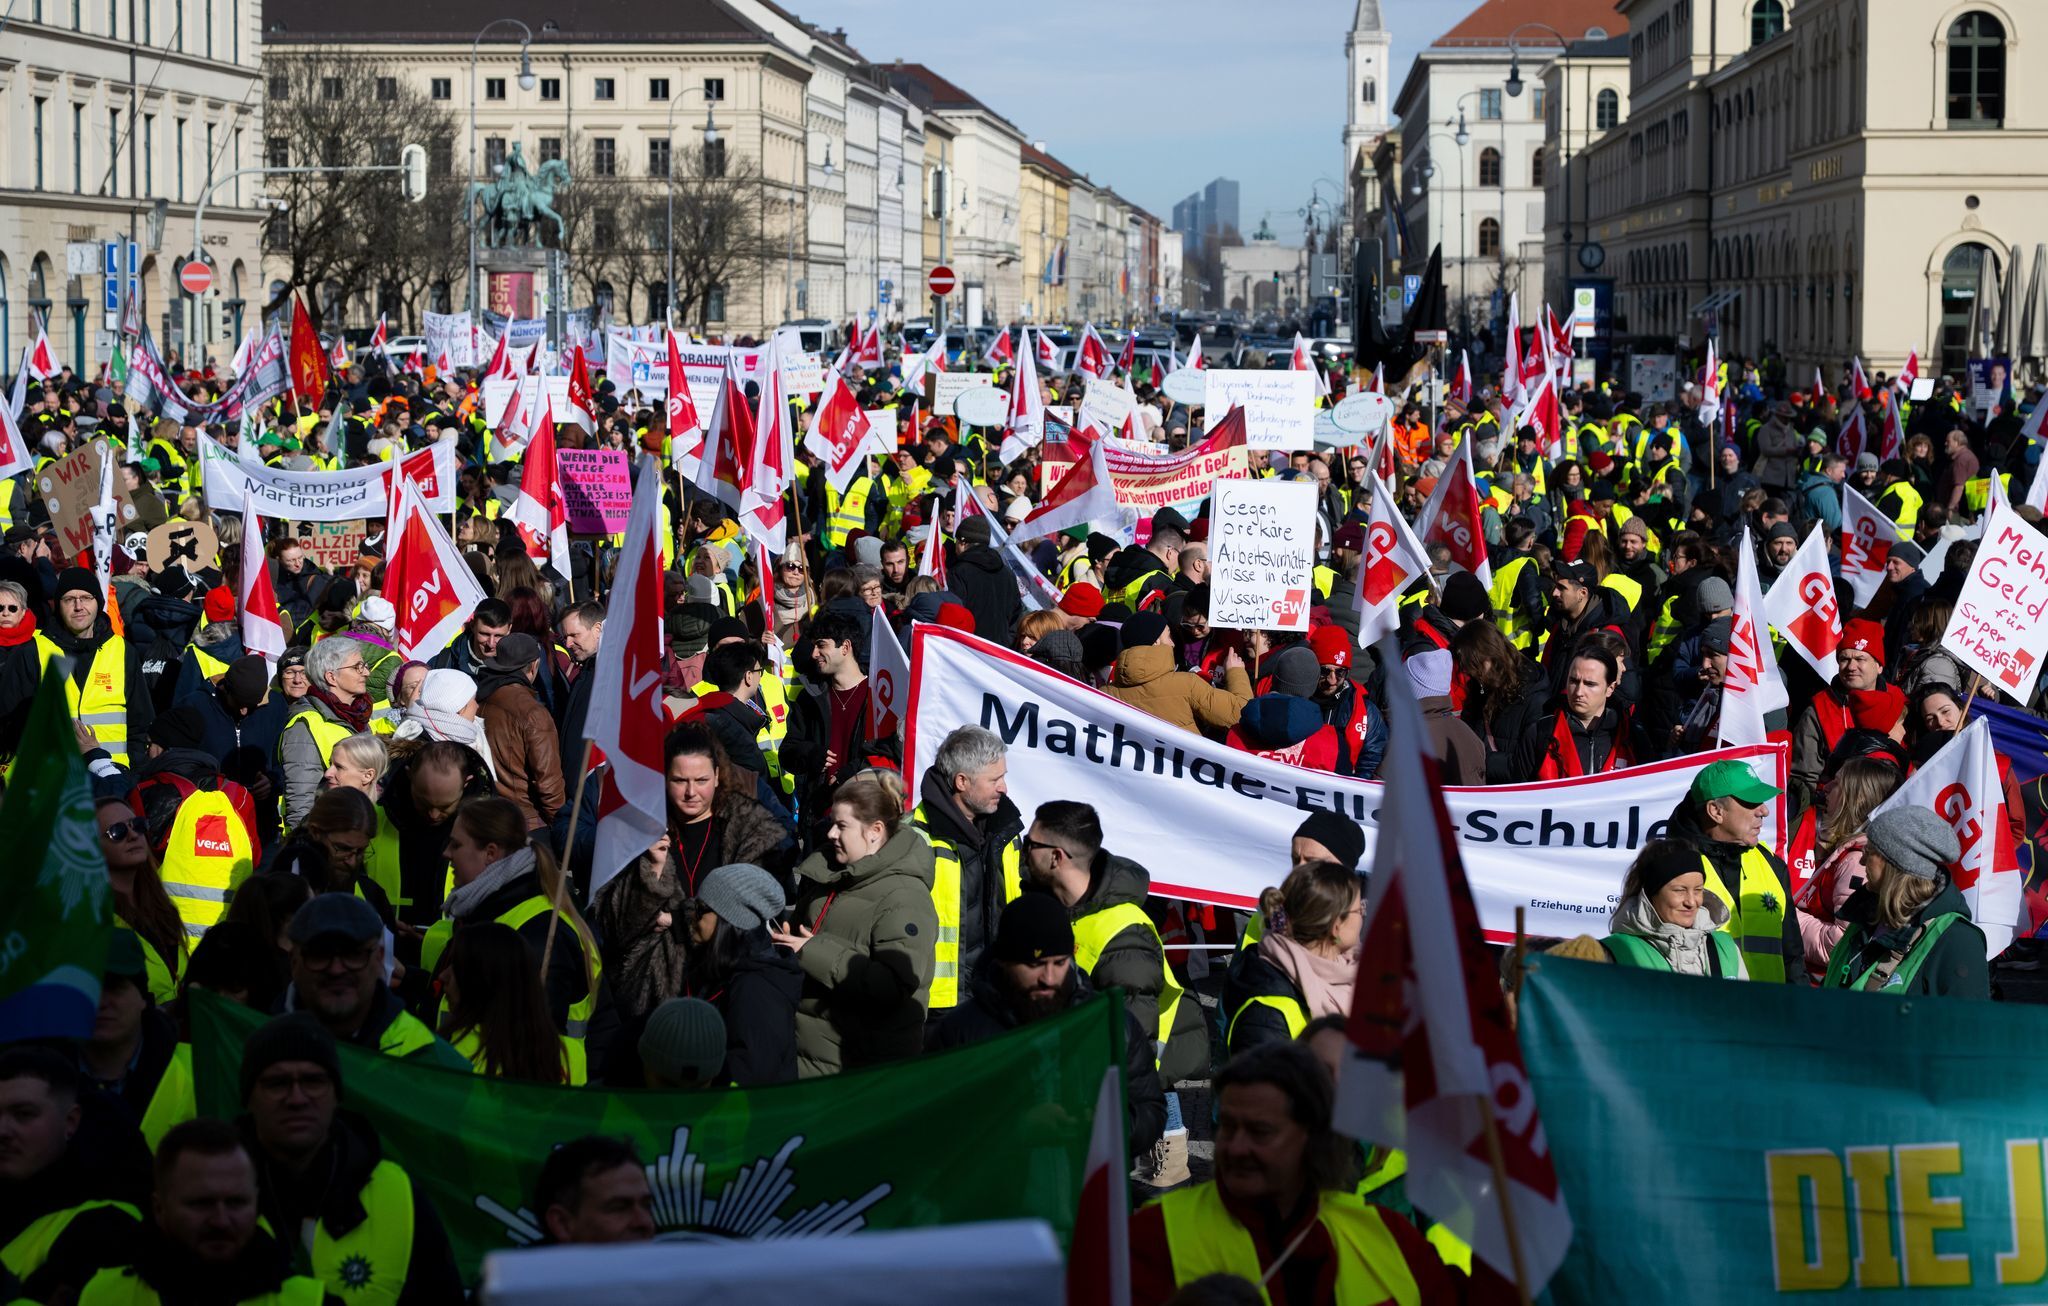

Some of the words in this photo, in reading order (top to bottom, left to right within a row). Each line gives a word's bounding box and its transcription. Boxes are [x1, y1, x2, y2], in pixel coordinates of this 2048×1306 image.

[1408, 276, 1417, 289] U
[653, 350, 738, 367] AUOBAHNER
[651, 372, 665, 381] WIR
[703, 376, 719, 385] DEN
[560, 453, 597, 463] WENN
[602, 455, 620, 464] DIE
[563, 464, 605, 473] PFLEGE
[55, 453, 91, 486] WIR
[1113, 476, 1132, 489] vor
[1204, 454, 1229, 474] Geld
[245, 477, 367, 509] Martinsried
[273, 477, 368, 494] Campus
[1222, 490, 1277, 526] Gegen
[1222, 520, 1294, 545] prekäre
[317, 550, 358, 566] TEUE
[1998, 526, 2048, 585] Meh
[1220, 565, 1256, 582] nisse
[1265, 568, 1276, 582] in
[1281, 571, 1305, 586] der
[1978, 557, 2048, 623] Geld
[1271, 600, 1306, 615] GEW
[1960, 602, 2006, 643] Super
[1995, 608, 2026, 632] für
[1999, 650, 2031, 681] GEW
[1355, 722, 1368, 733] GE
[196, 838, 231, 853] ver.di
[1531, 899, 1583, 913] Erziehung
[1585, 904, 1606, 914] und
[1764, 1142, 1971, 1293] DIE
